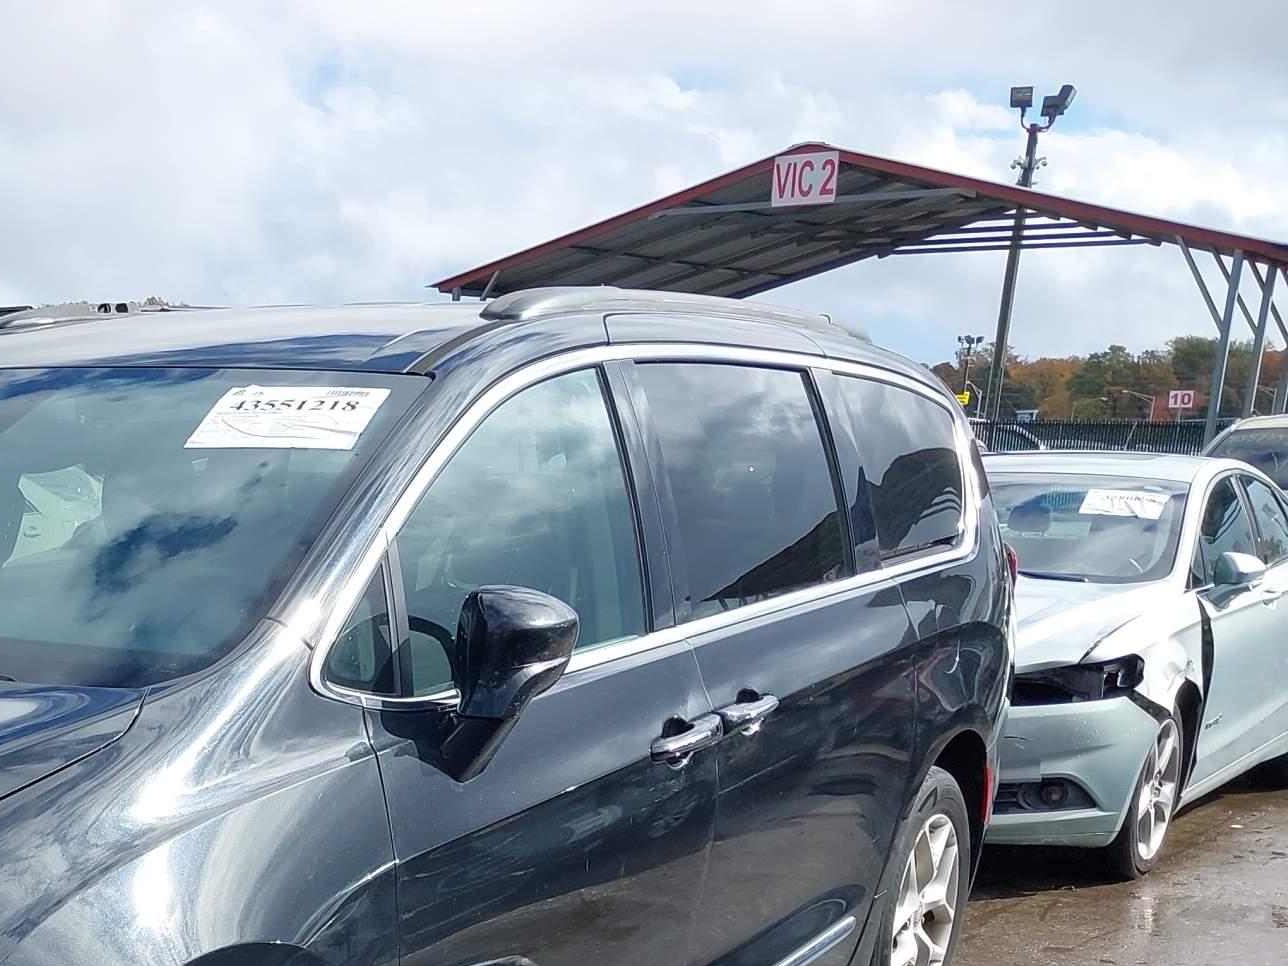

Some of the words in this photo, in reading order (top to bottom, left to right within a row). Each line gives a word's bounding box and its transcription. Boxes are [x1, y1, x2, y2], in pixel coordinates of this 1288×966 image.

[776, 160, 814, 199] VIC
[819, 159, 836, 195] 2
[230, 399, 361, 411] 43551218
[1170, 392, 1192, 406] 10
